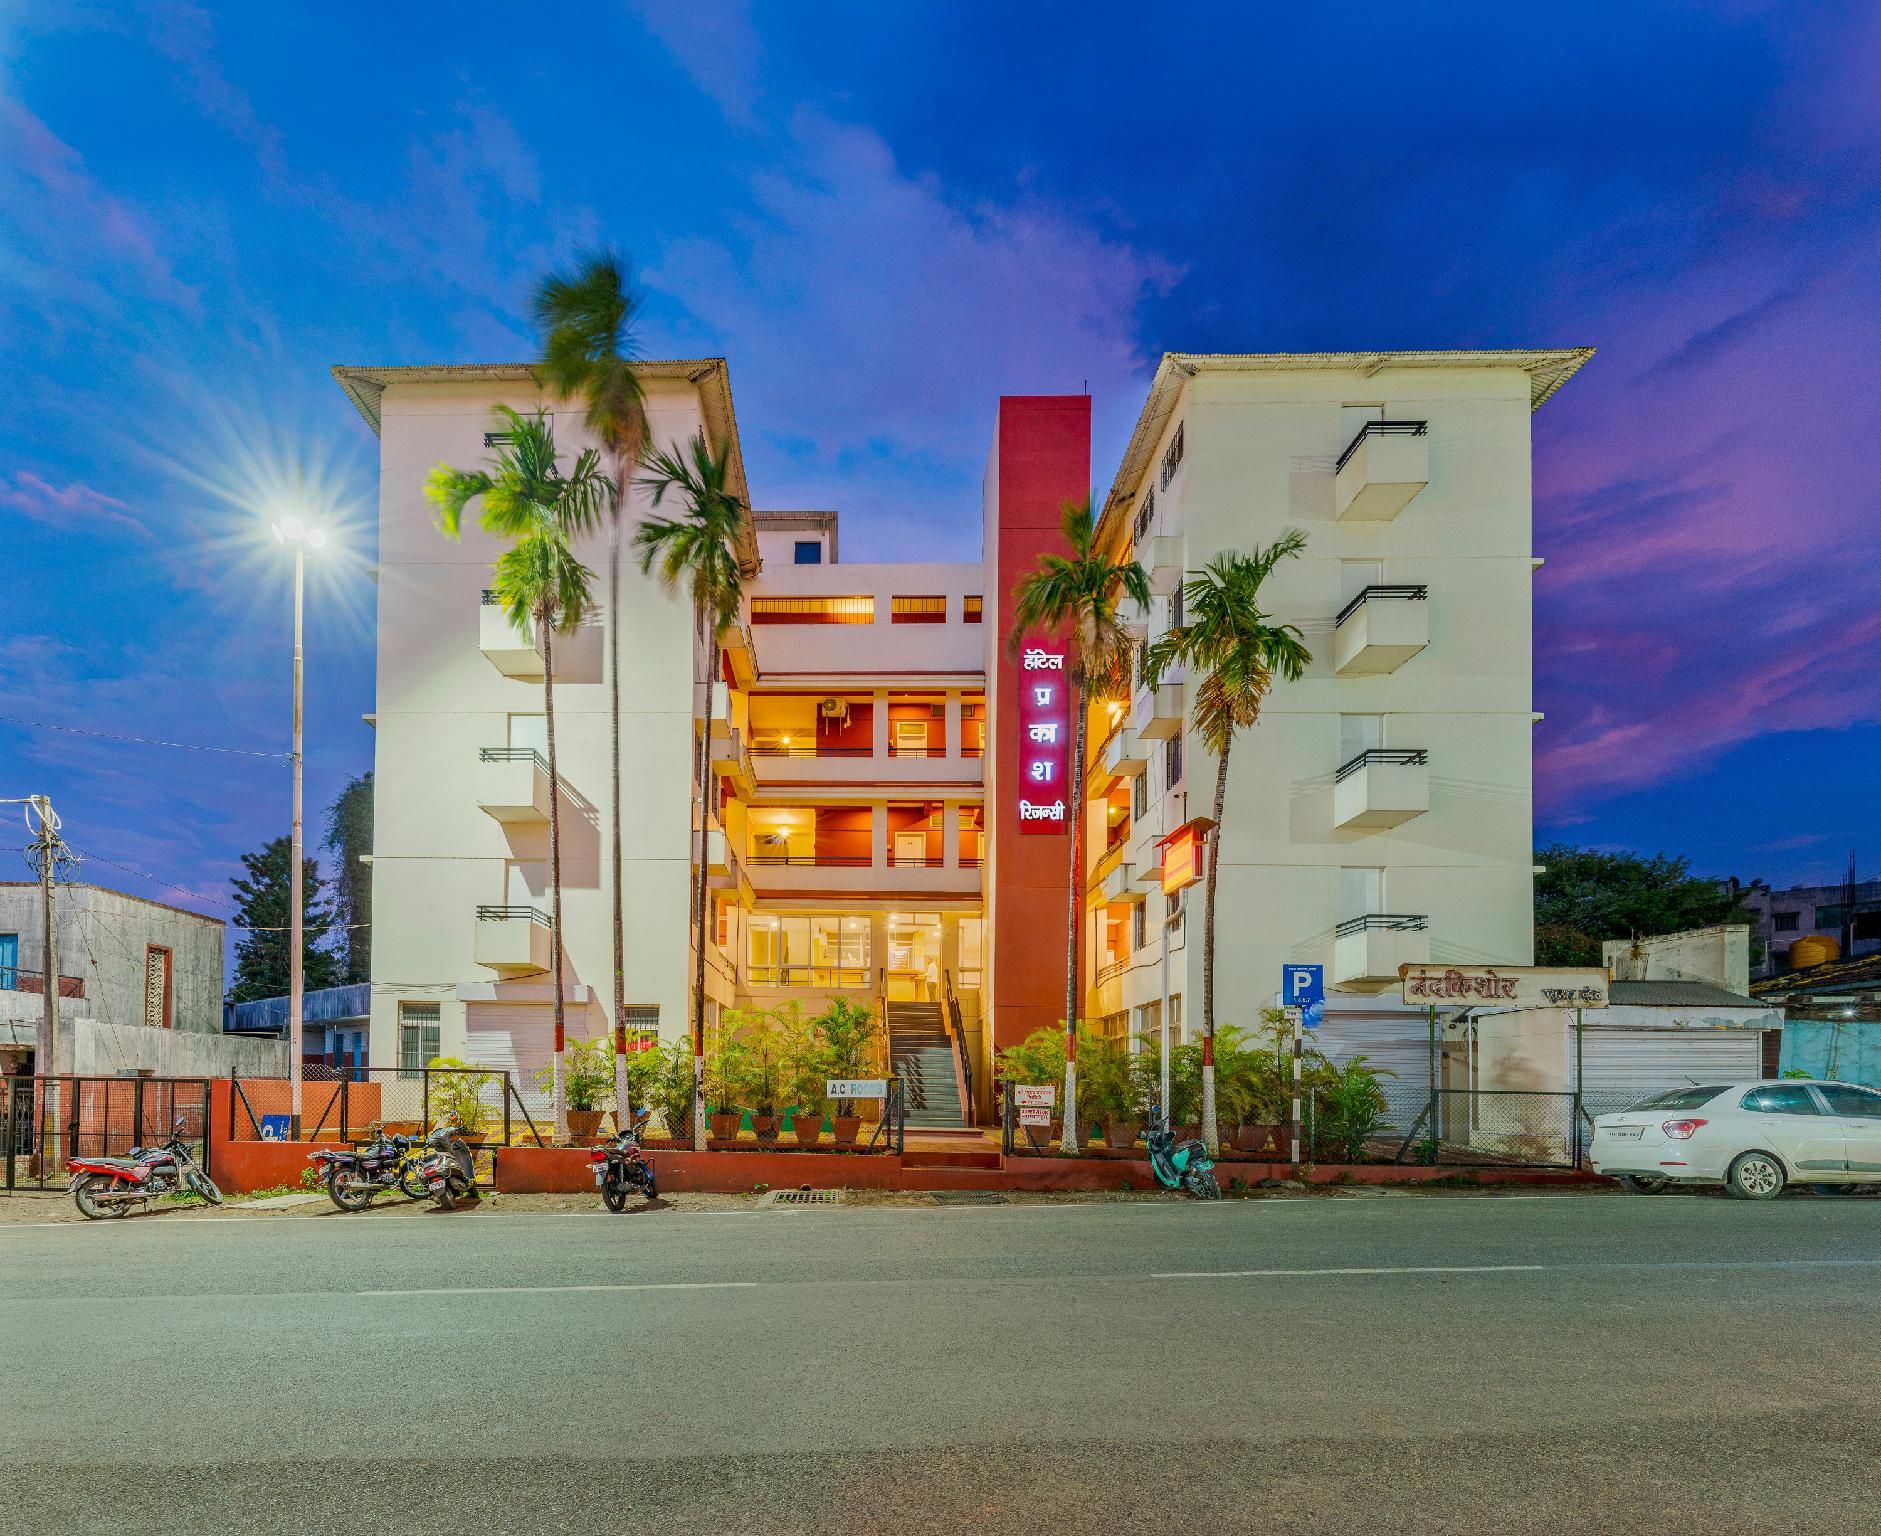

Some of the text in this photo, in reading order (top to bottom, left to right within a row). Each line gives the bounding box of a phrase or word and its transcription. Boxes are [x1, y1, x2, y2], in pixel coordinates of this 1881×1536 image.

[1024, 649, 1064, 670] हॉटेल
[1020, 799, 1065, 820] रिजन्सी
[1293, 971, 1312, 997] P
[1409, 969, 1519, 1000] नंदकिशोर
